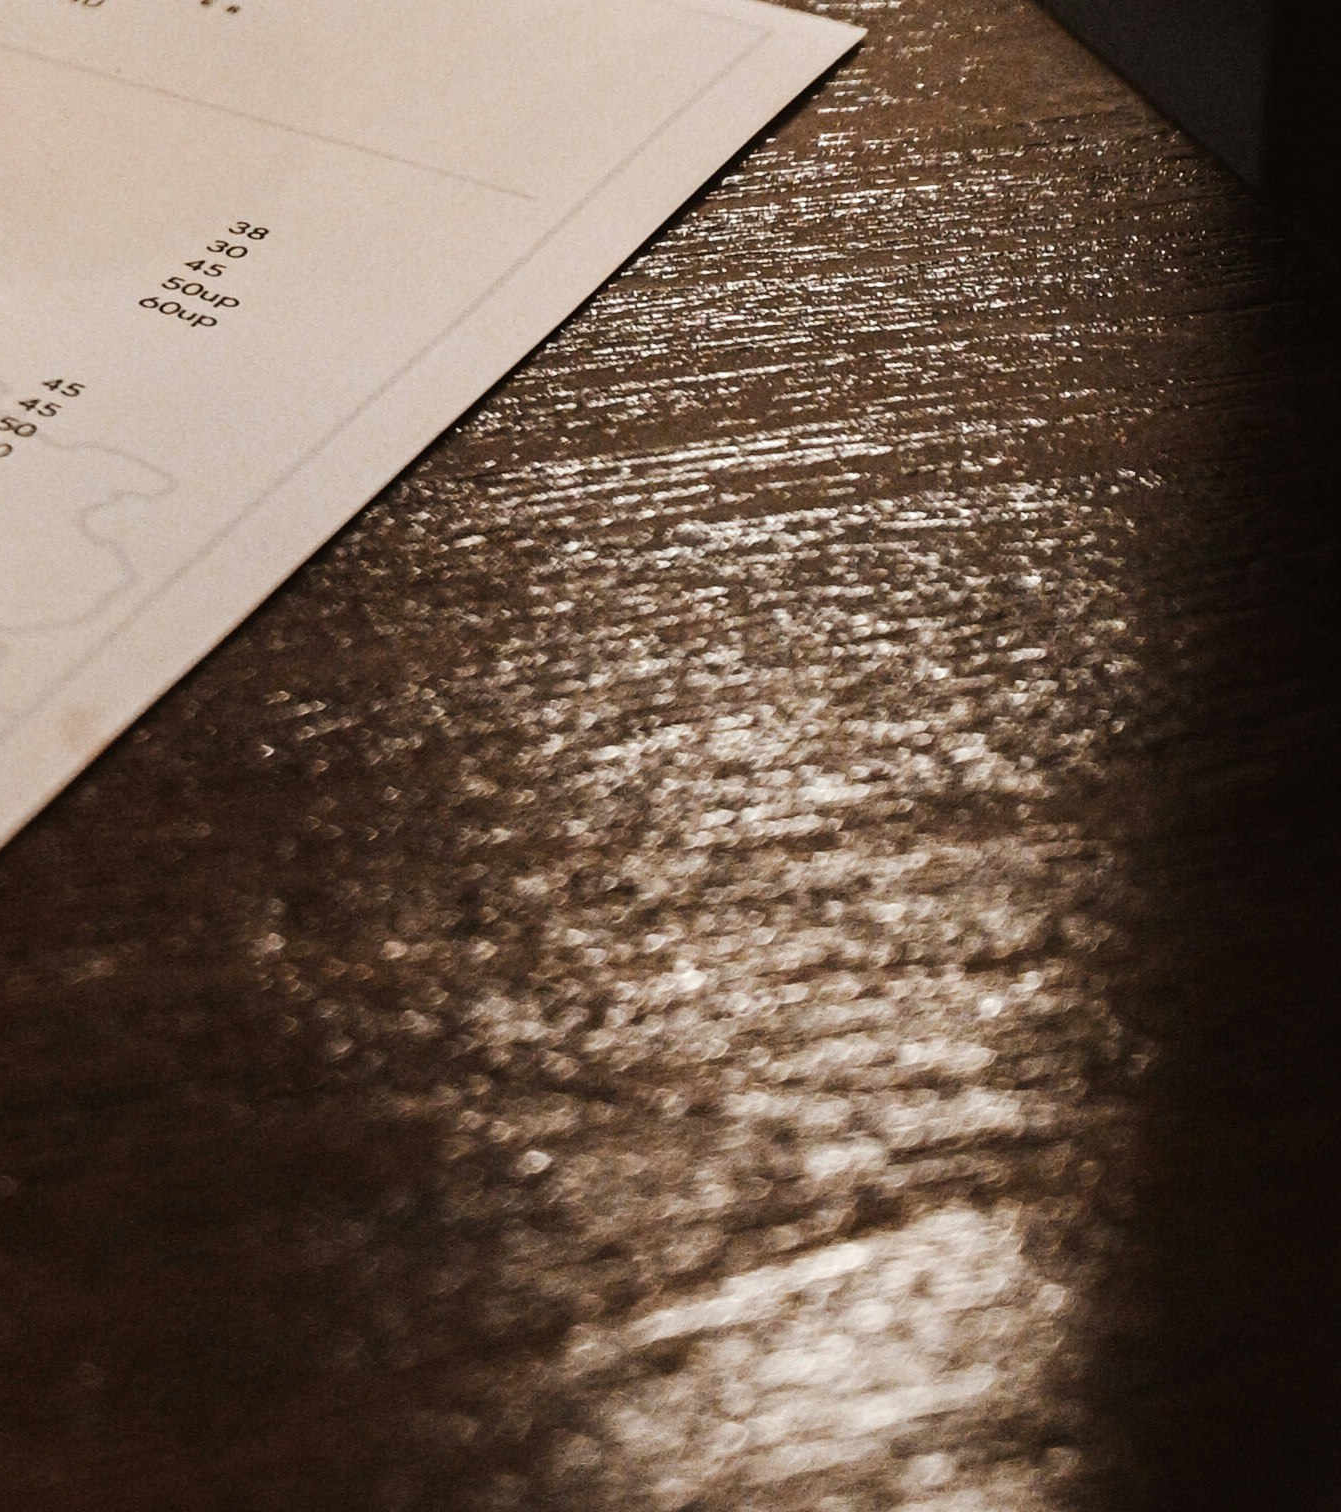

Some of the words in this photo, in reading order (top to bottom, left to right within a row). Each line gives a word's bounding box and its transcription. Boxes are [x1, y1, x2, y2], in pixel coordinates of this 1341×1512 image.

[227, 220, 271, 241] 38
[205, 239, 249, 259] 30
[184, 259, 227, 278] 45
[160, 276, 241, 309] 50up
[138, 296, 220, 328] 60up
[41, 378, 86, 398] 45
[17, 398, 62, 418] 45
